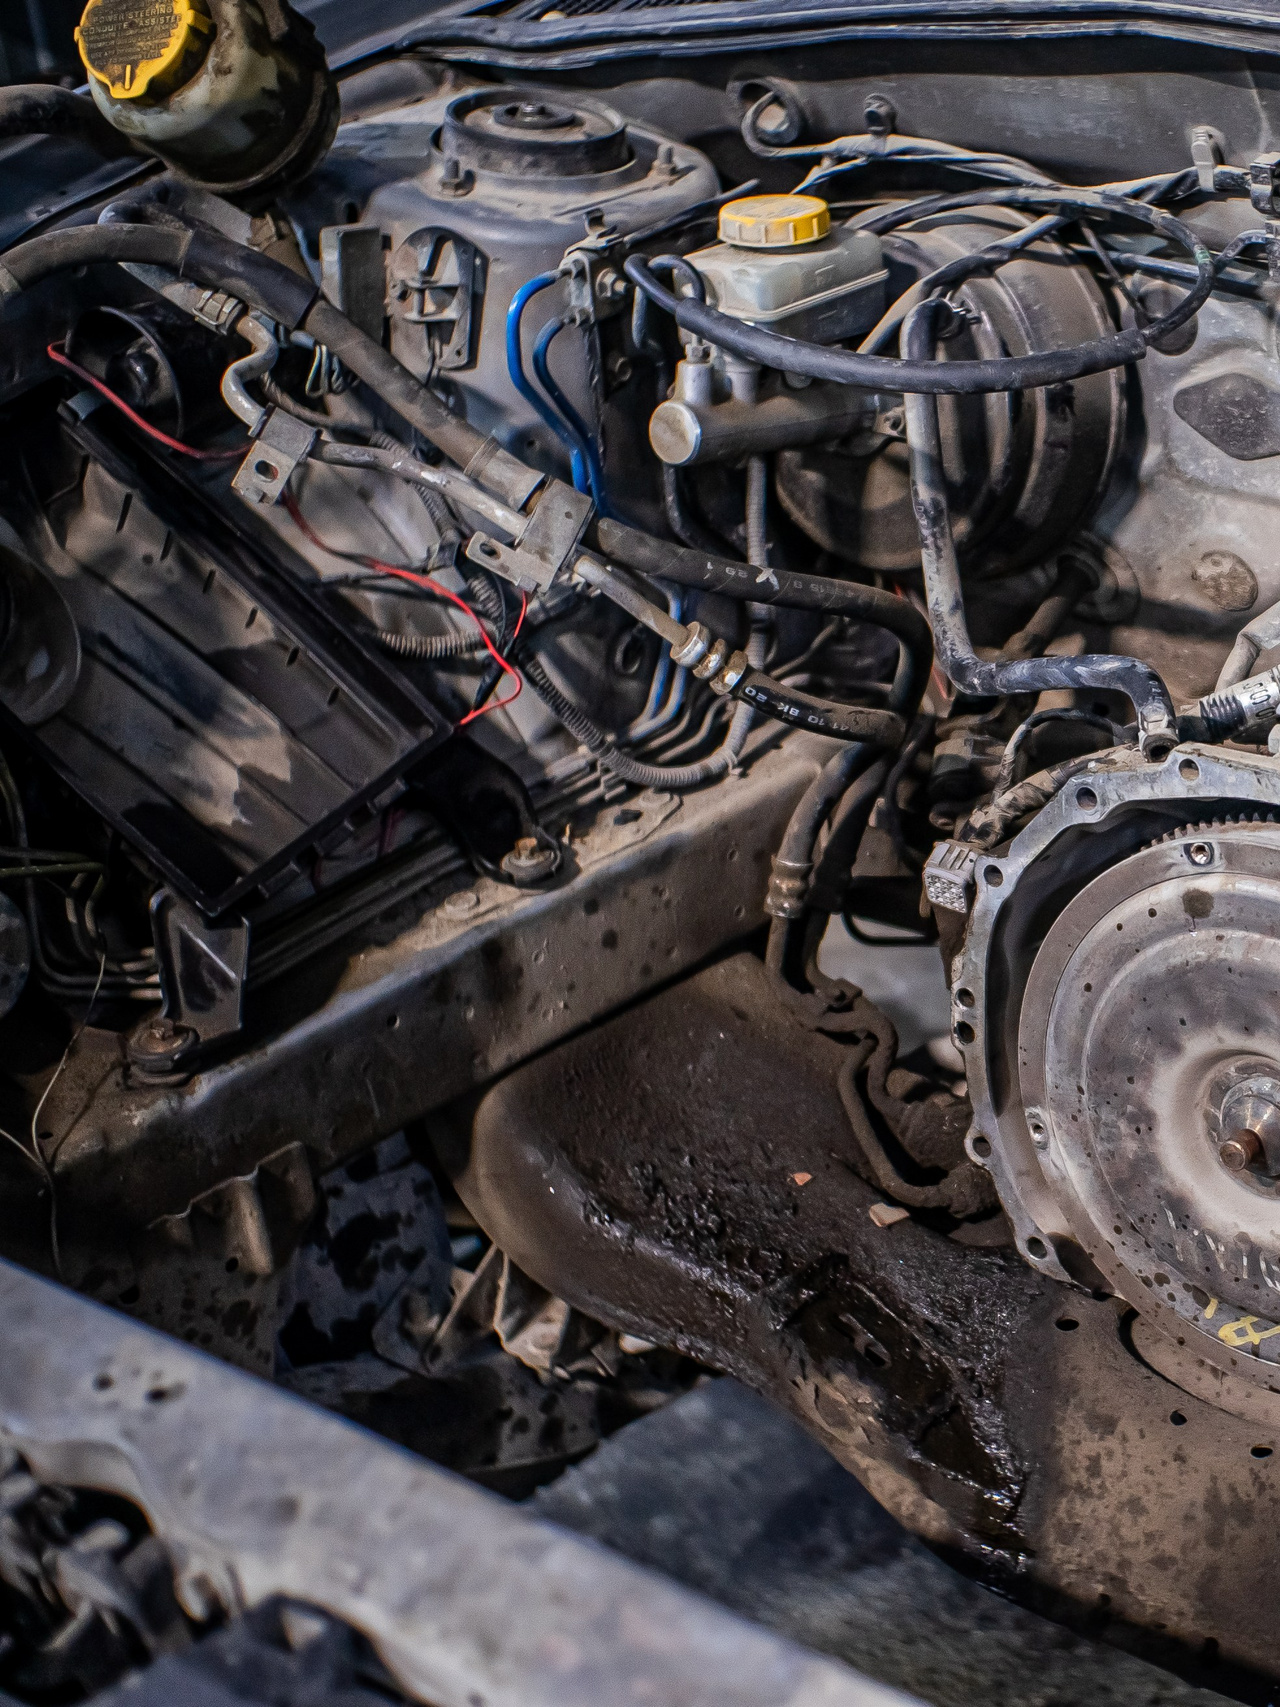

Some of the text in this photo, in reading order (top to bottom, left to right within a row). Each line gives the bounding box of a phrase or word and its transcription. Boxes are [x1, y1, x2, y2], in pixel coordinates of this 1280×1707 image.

[93, 13, 125, 24] POWER
[128, 5, 172, 19] STEERING
[82, 21, 128, 35] CONDUITE
[744, 686, 768, 703] 20
[777, 702, 800, 717] BK
